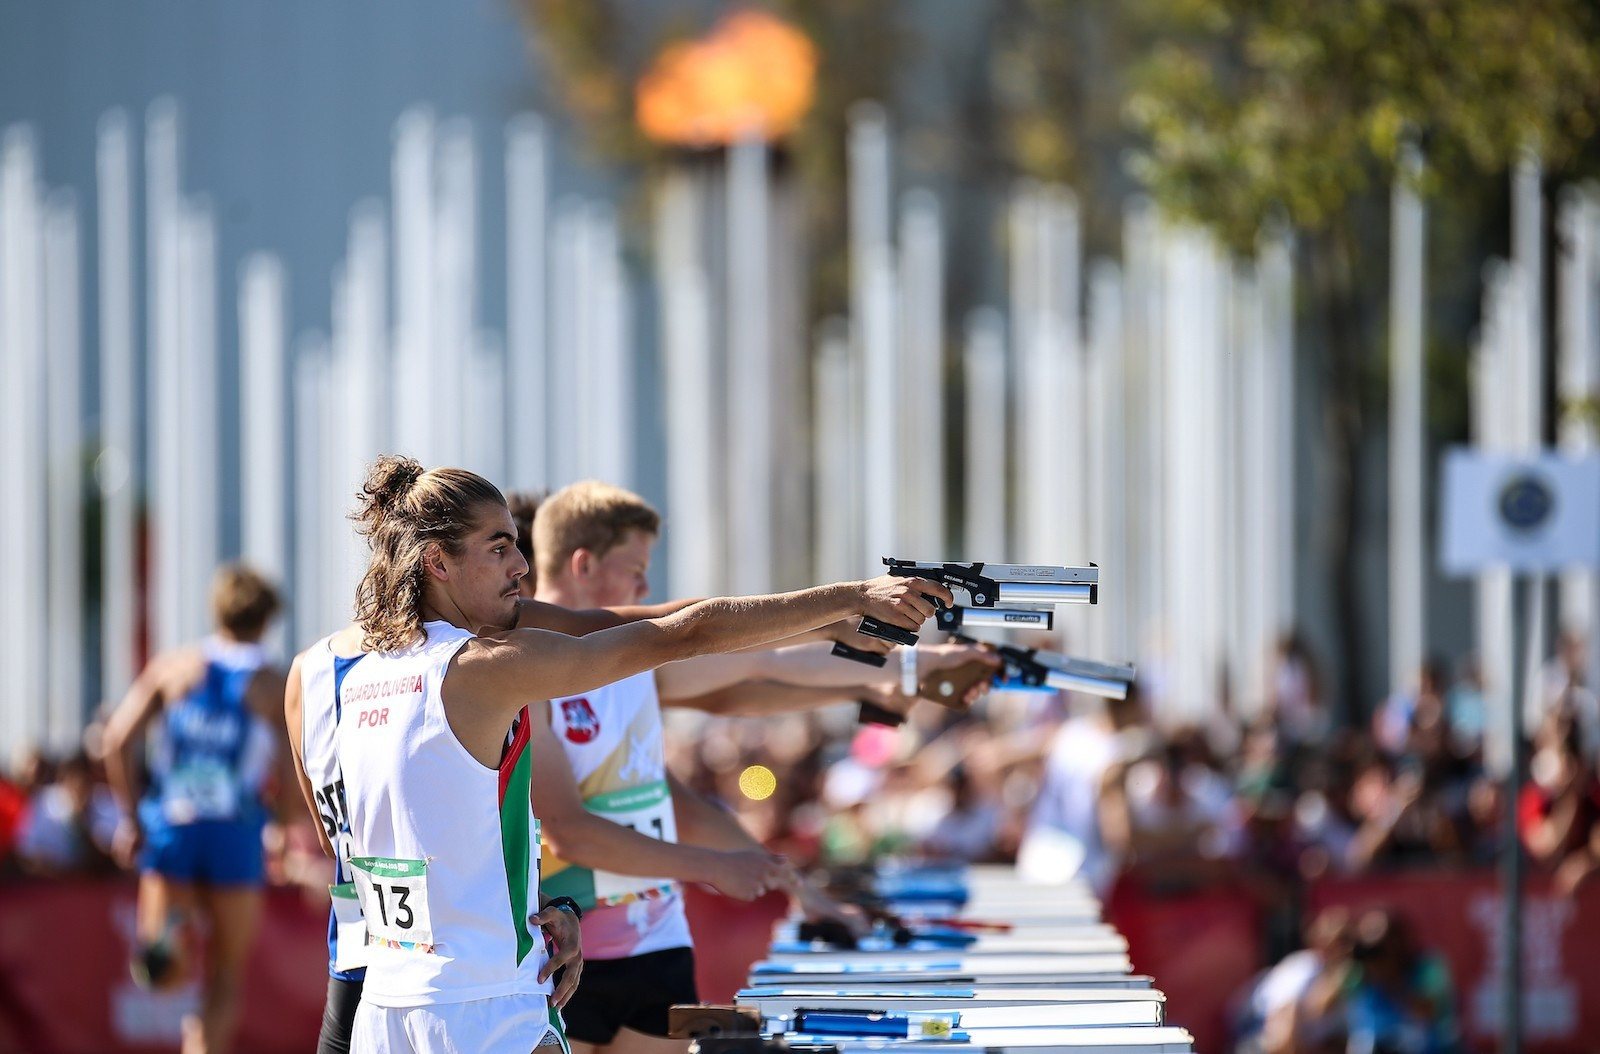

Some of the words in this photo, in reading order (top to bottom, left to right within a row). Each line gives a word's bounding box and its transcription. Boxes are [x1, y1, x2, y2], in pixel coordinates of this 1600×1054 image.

[343, 682, 381, 706] EDUARDO
[382, 674, 423, 698] OLIVEIRA
[358, 707, 390, 729] POR
[372, 883, 414, 929] 13
